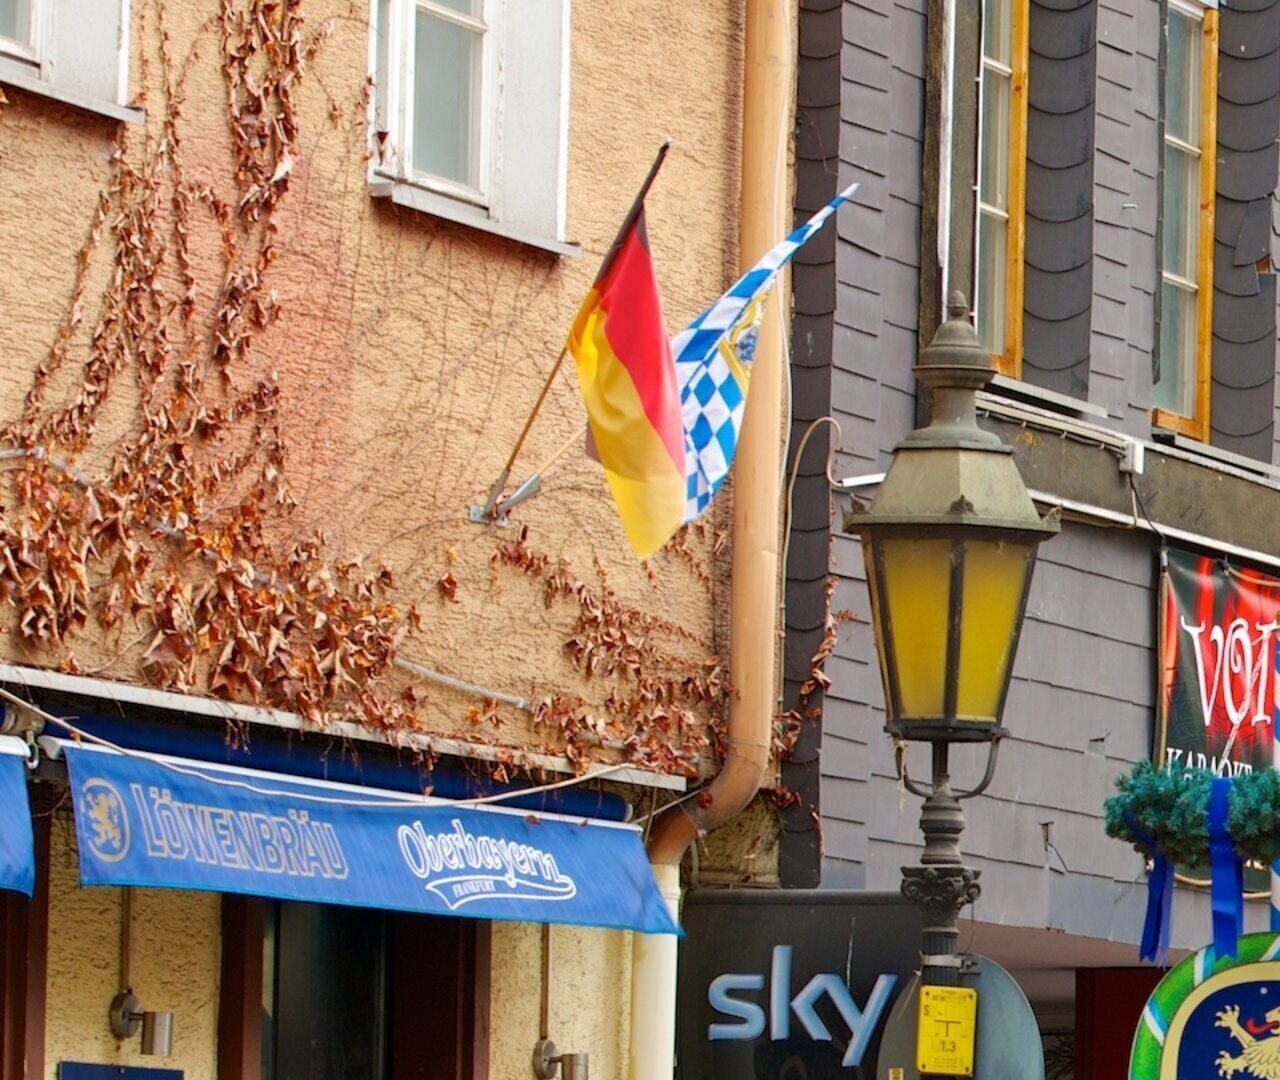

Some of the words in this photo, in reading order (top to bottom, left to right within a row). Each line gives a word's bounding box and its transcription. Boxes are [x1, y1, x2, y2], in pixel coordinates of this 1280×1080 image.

[129, 782, 350, 880] LÖWENBRÄU
[397, 818, 566, 888] Oberbayern
[452, 880, 497, 899] FRANKFURT
[707, 945, 899, 1067] sky
